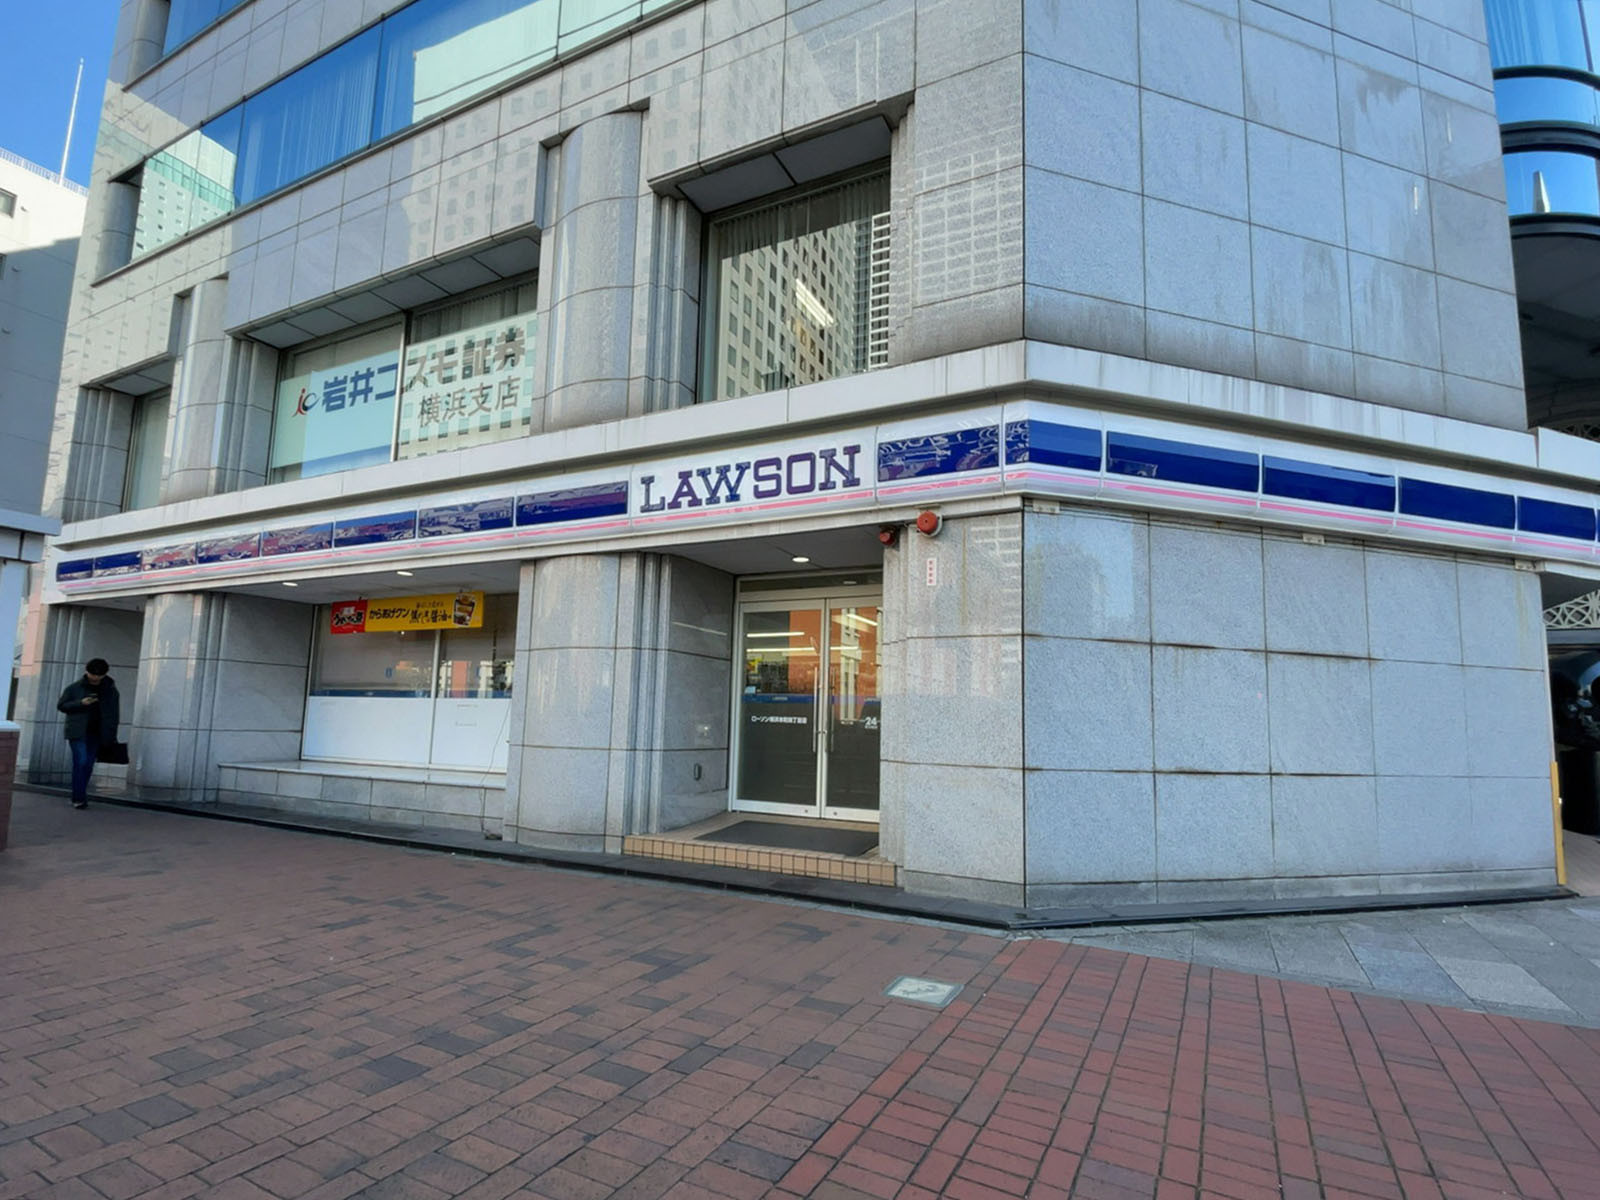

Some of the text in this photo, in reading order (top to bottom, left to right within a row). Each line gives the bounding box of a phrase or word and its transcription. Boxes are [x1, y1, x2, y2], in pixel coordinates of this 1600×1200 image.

[322, 327, 526, 413] 岩井コスモ証券
[419, 375, 521, 428] 横浜支店
[640, 444, 861, 513] LAWSON
